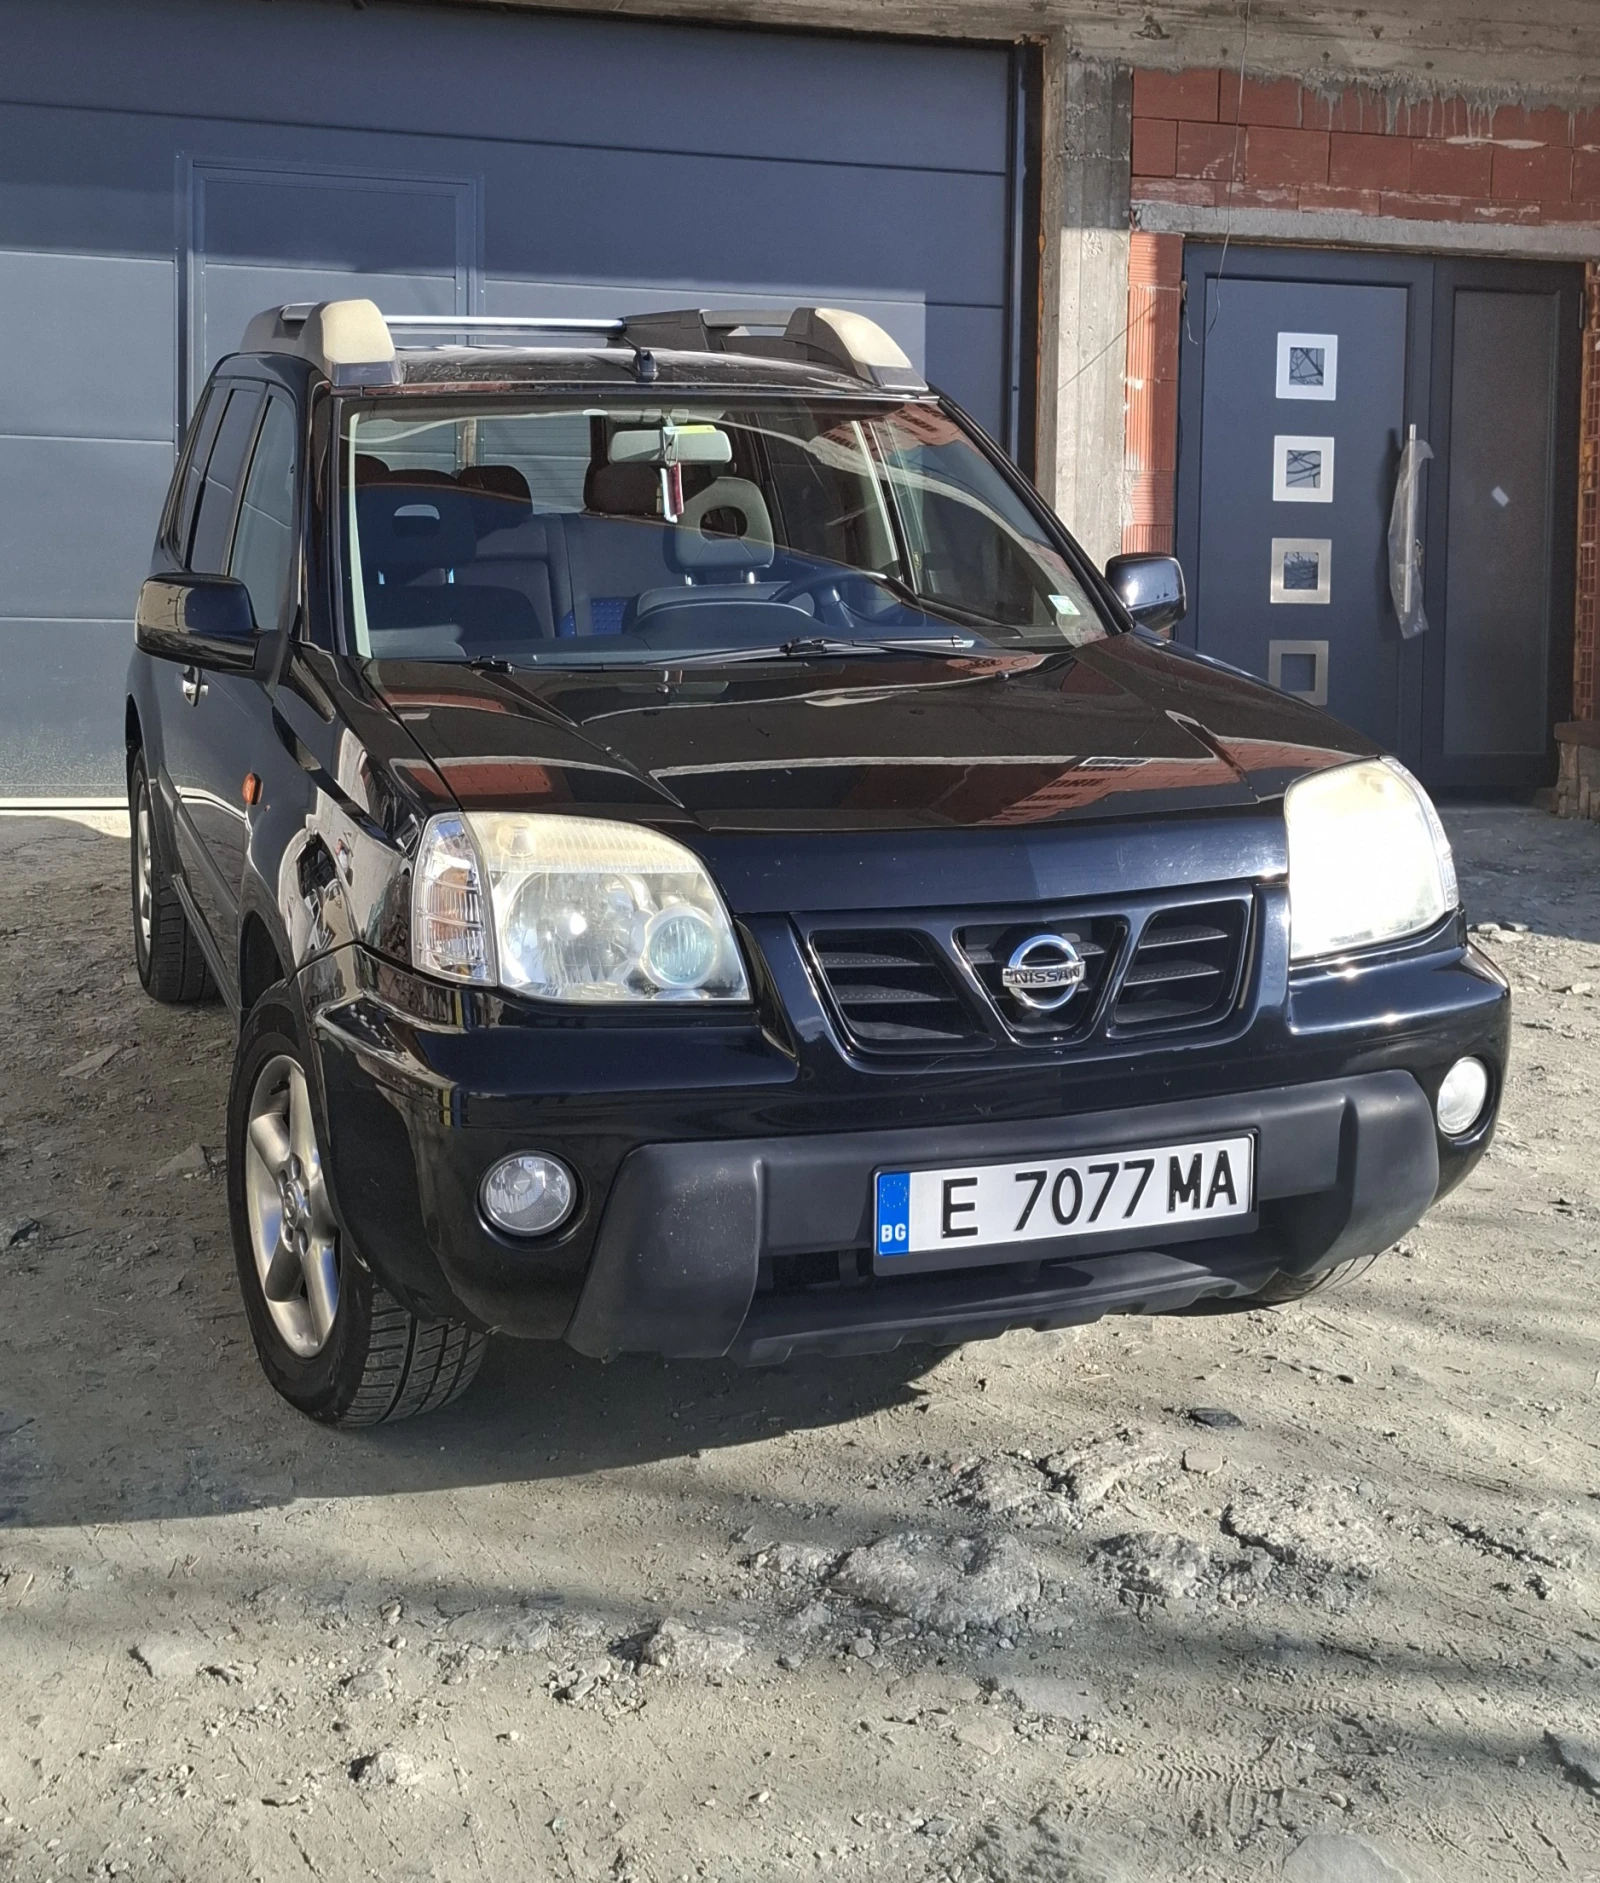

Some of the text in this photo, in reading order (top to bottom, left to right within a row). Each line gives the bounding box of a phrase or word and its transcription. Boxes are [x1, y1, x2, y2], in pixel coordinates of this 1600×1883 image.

[1013, 966, 1080, 984] NISSAN
[941, 1150, 1238, 1239] E 7077 MA
[881, 1223, 907, 1243] BG
